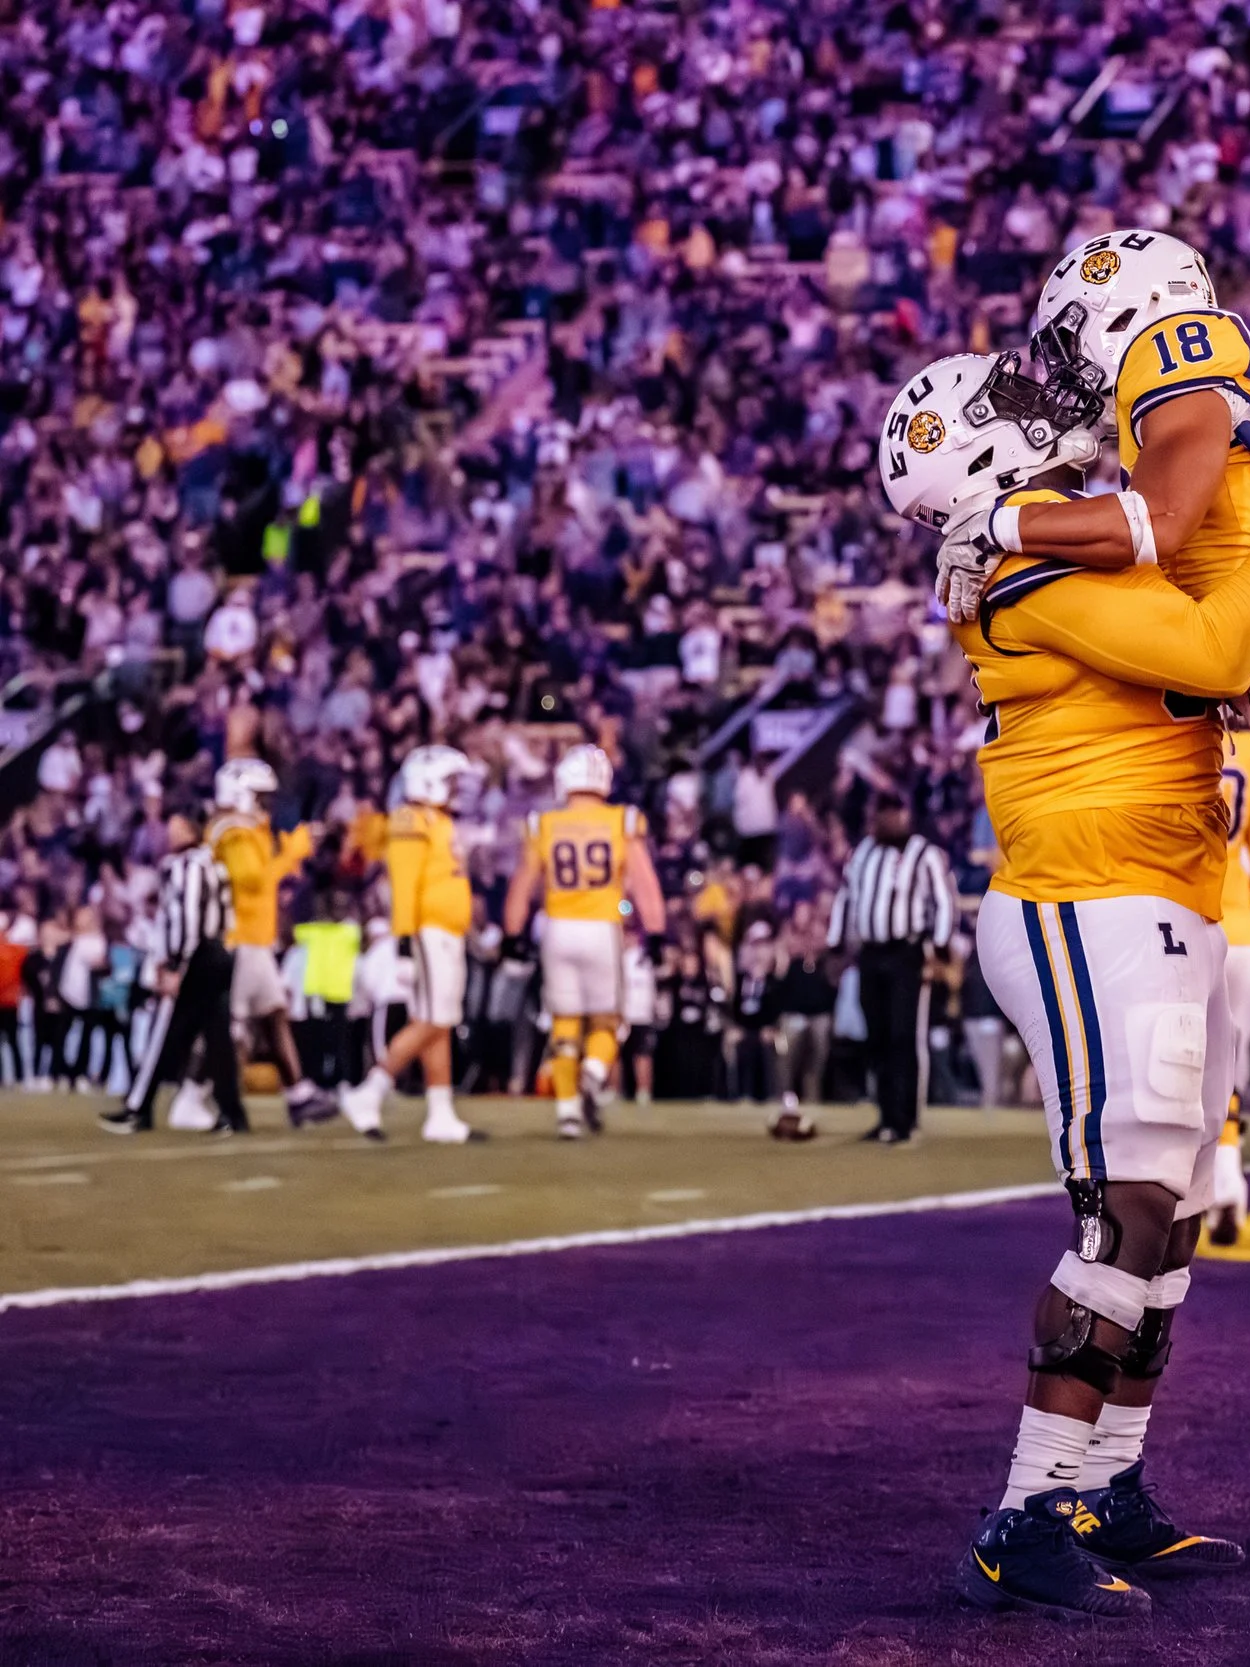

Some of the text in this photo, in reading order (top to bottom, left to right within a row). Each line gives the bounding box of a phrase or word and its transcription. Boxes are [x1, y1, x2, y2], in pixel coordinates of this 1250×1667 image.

[1150, 320, 1215, 376] 18
[887, 375, 934, 481] LSU
[552, 840, 613, 889] 89
[1157, 922, 1188, 956] L
